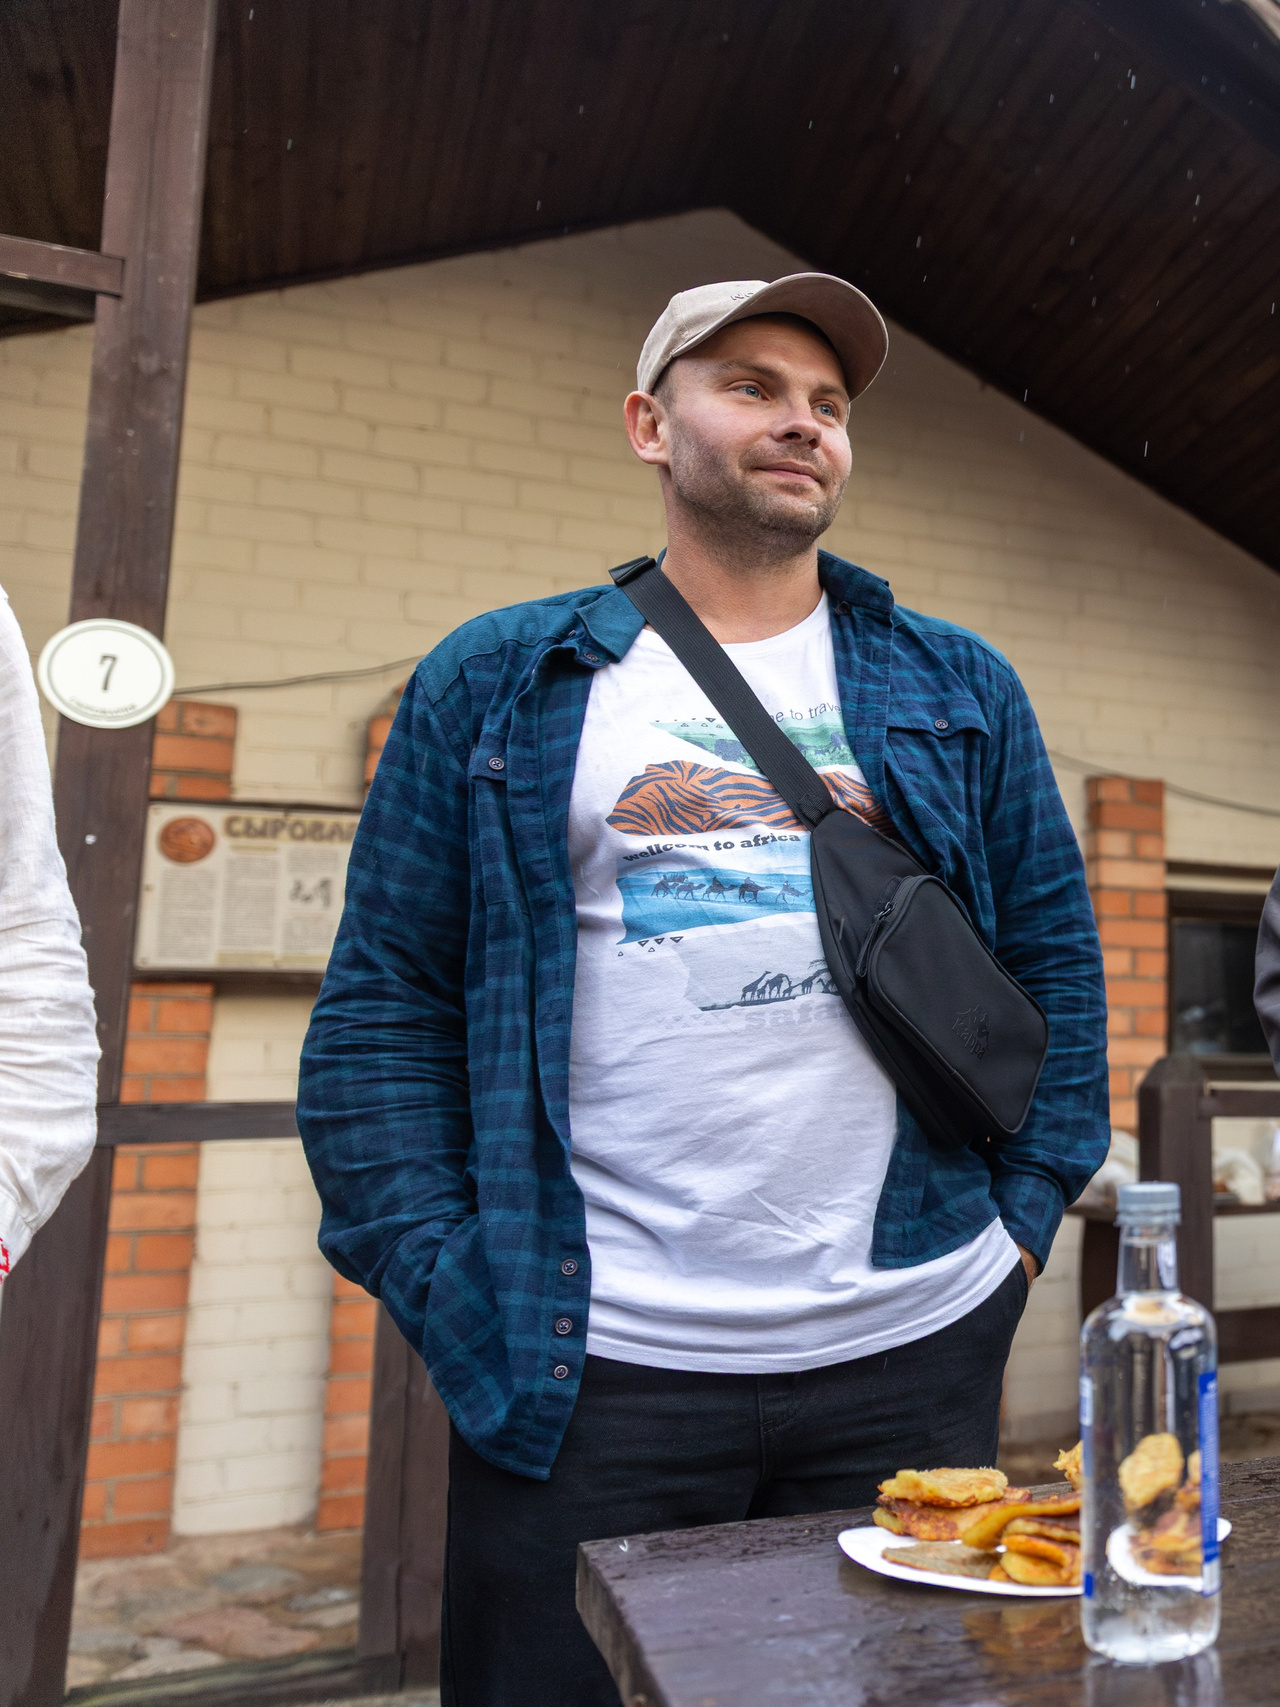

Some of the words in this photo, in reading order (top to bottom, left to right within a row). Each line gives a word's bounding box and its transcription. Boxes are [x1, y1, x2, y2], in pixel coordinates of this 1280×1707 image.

[99, 653, 117, 692] 7
[789, 708, 804, 721] to
[622, 842, 709, 862] wellcom
[713, 840, 735, 851] to
[740, 832, 802, 849] africa
